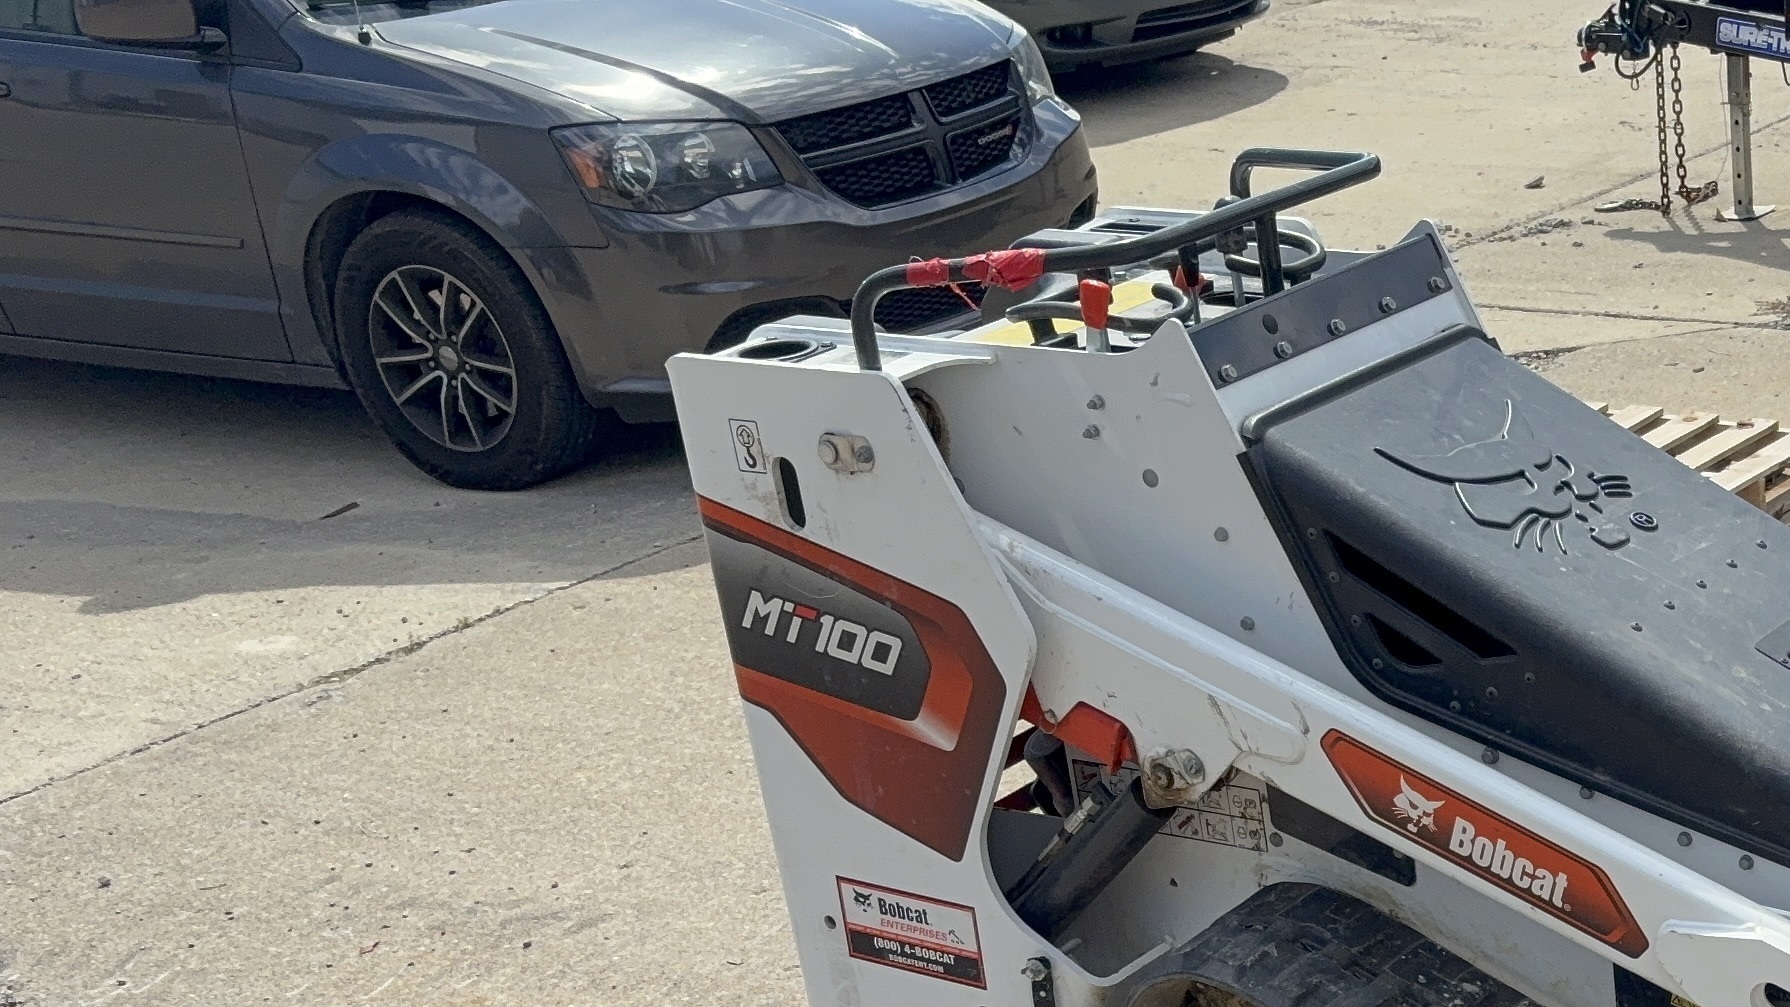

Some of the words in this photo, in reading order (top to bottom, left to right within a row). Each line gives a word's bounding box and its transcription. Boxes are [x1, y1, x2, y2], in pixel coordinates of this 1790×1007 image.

[741, 589, 903, 676] MT100
[1449, 816, 1569, 908] Bobcat
[877, 897, 930, 926] Bobcat
[880, 917, 949, 942] ENTERPRISES
[873, 936, 901, 954] (800)
[904, 944, 956, 965] 4-BOBCAT
